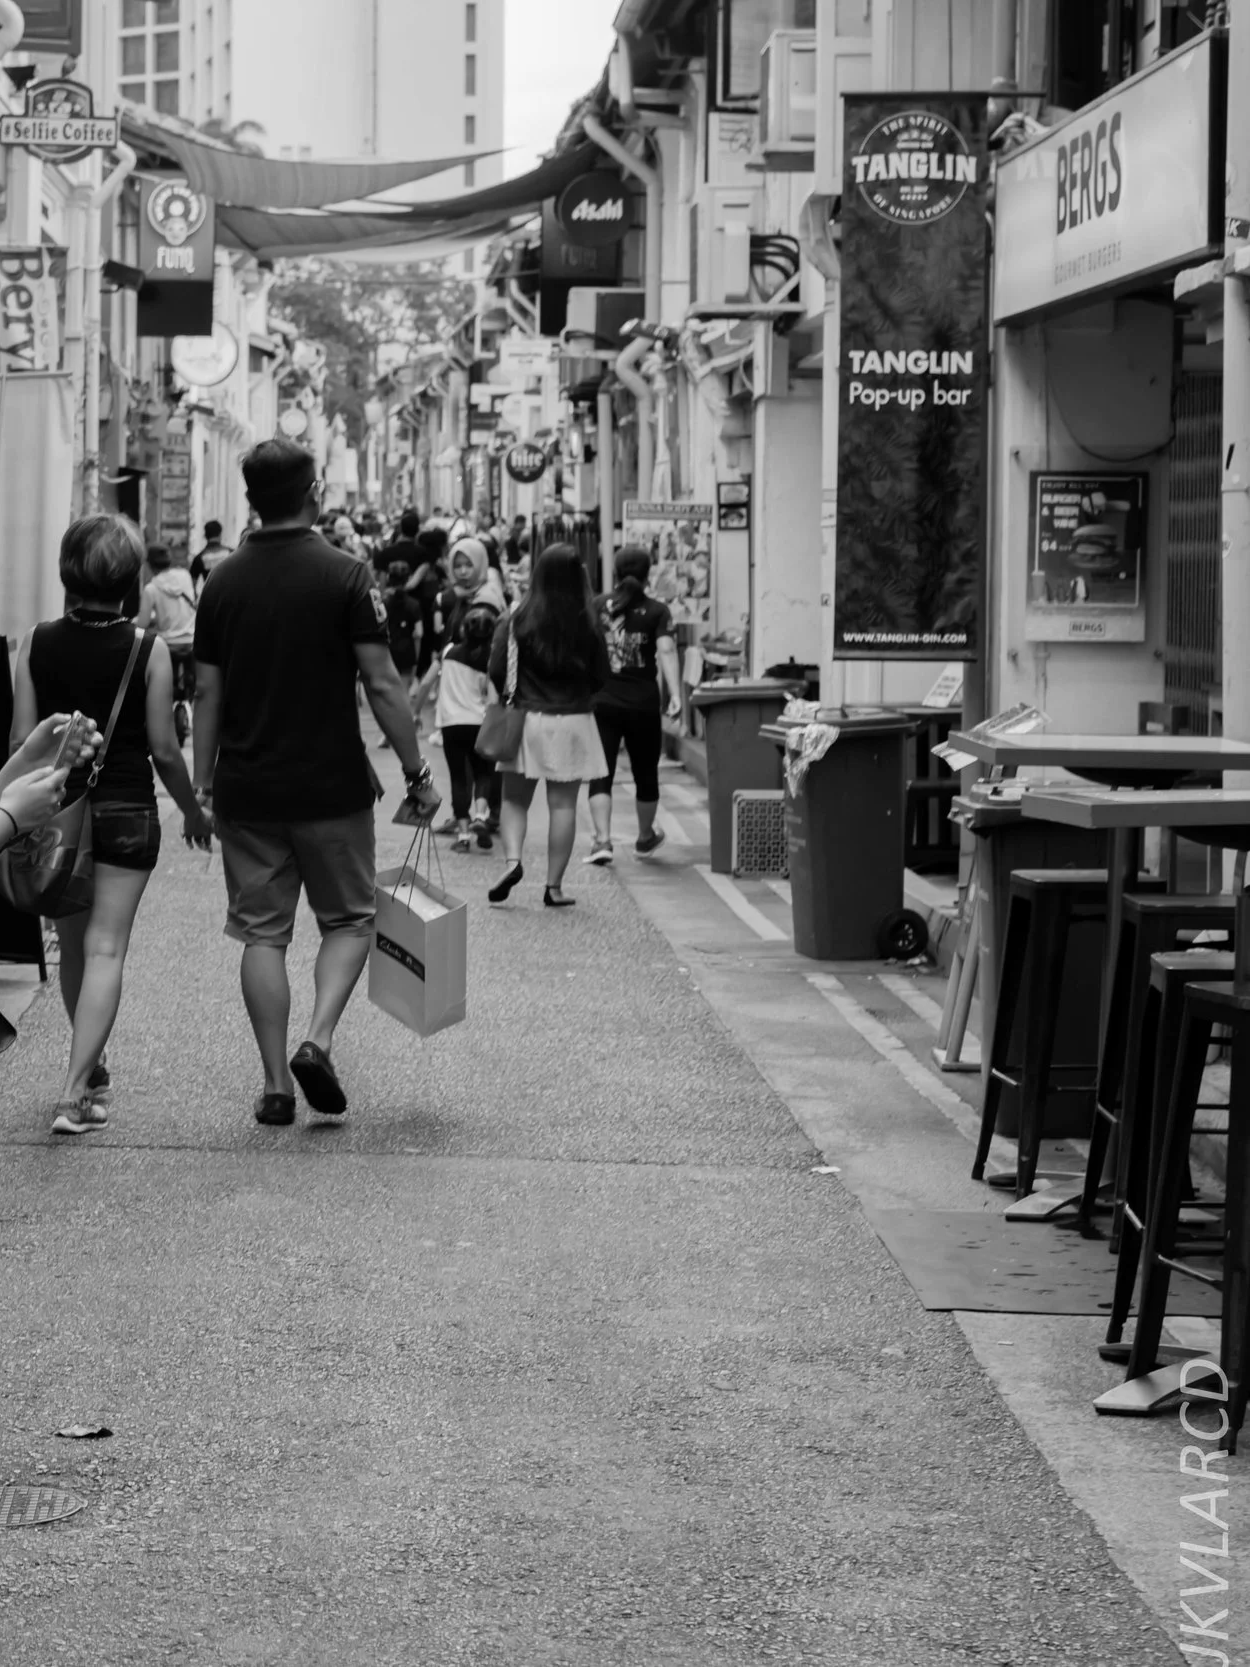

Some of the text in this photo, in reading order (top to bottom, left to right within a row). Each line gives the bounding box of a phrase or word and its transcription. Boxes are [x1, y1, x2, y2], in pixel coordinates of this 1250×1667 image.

[3, 121, 114, 142] #Selfie Coffee
[851, 151, 977, 183] TANGLIN
[1057, 111, 1122, 236] BERGS
[571, 198, 624, 221] Asahi
[848, 350, 973, 375] TANGLIN
[849, 380, 972, 411] Pop-up bar
[843, 632, 968, 645] WWW.TANGLIN-GIN.COM
[1071, 623, 1103, 633] BERGS
